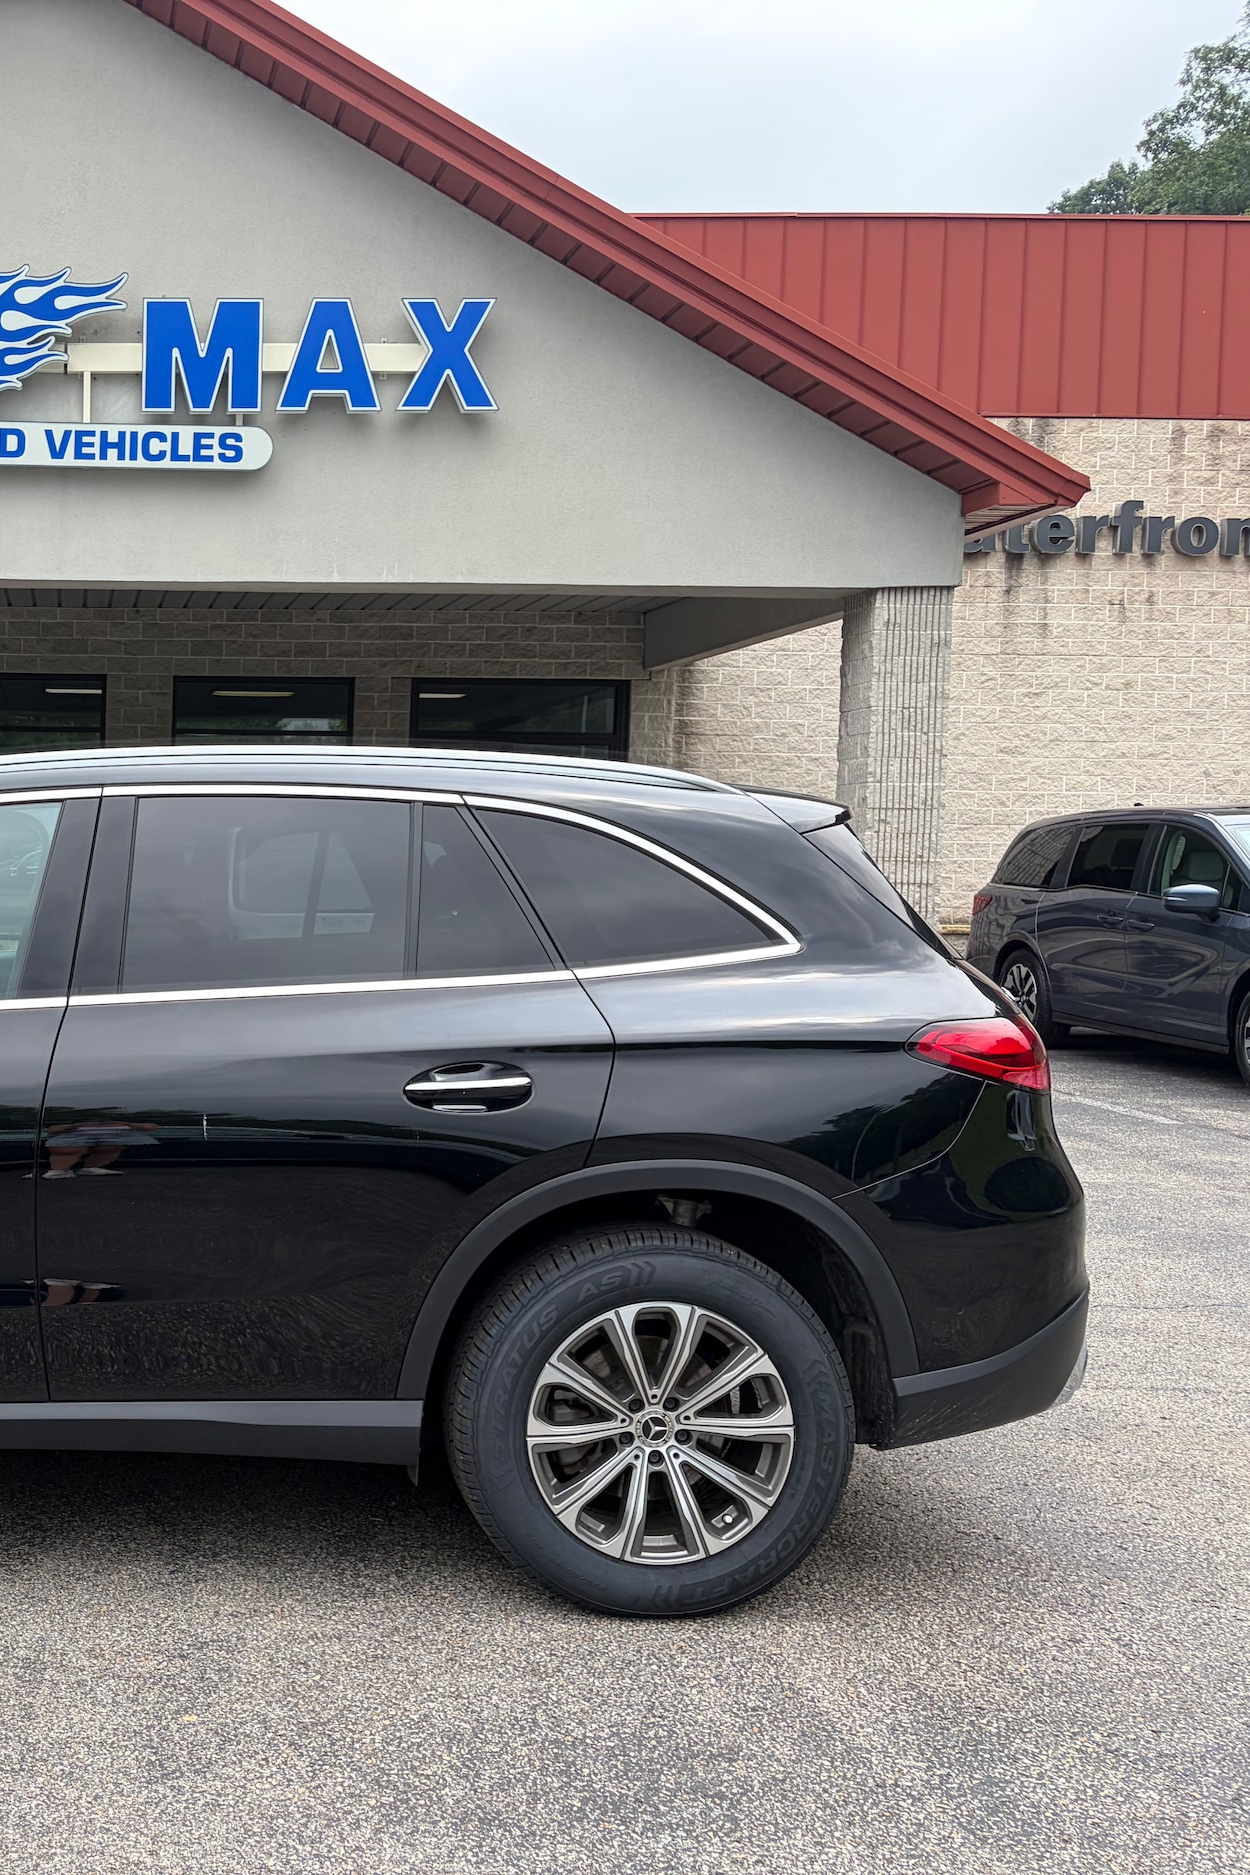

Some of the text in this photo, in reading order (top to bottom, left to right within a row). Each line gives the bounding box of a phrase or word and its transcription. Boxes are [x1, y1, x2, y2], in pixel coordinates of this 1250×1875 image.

[141, 297, 499, 414] MAX
[44, 428, 244, 463] VEHICLES
[491, 1271, 624, 1459] STRATUS AS
[684, 1390, 840, 1604] MASTERCRAFT
